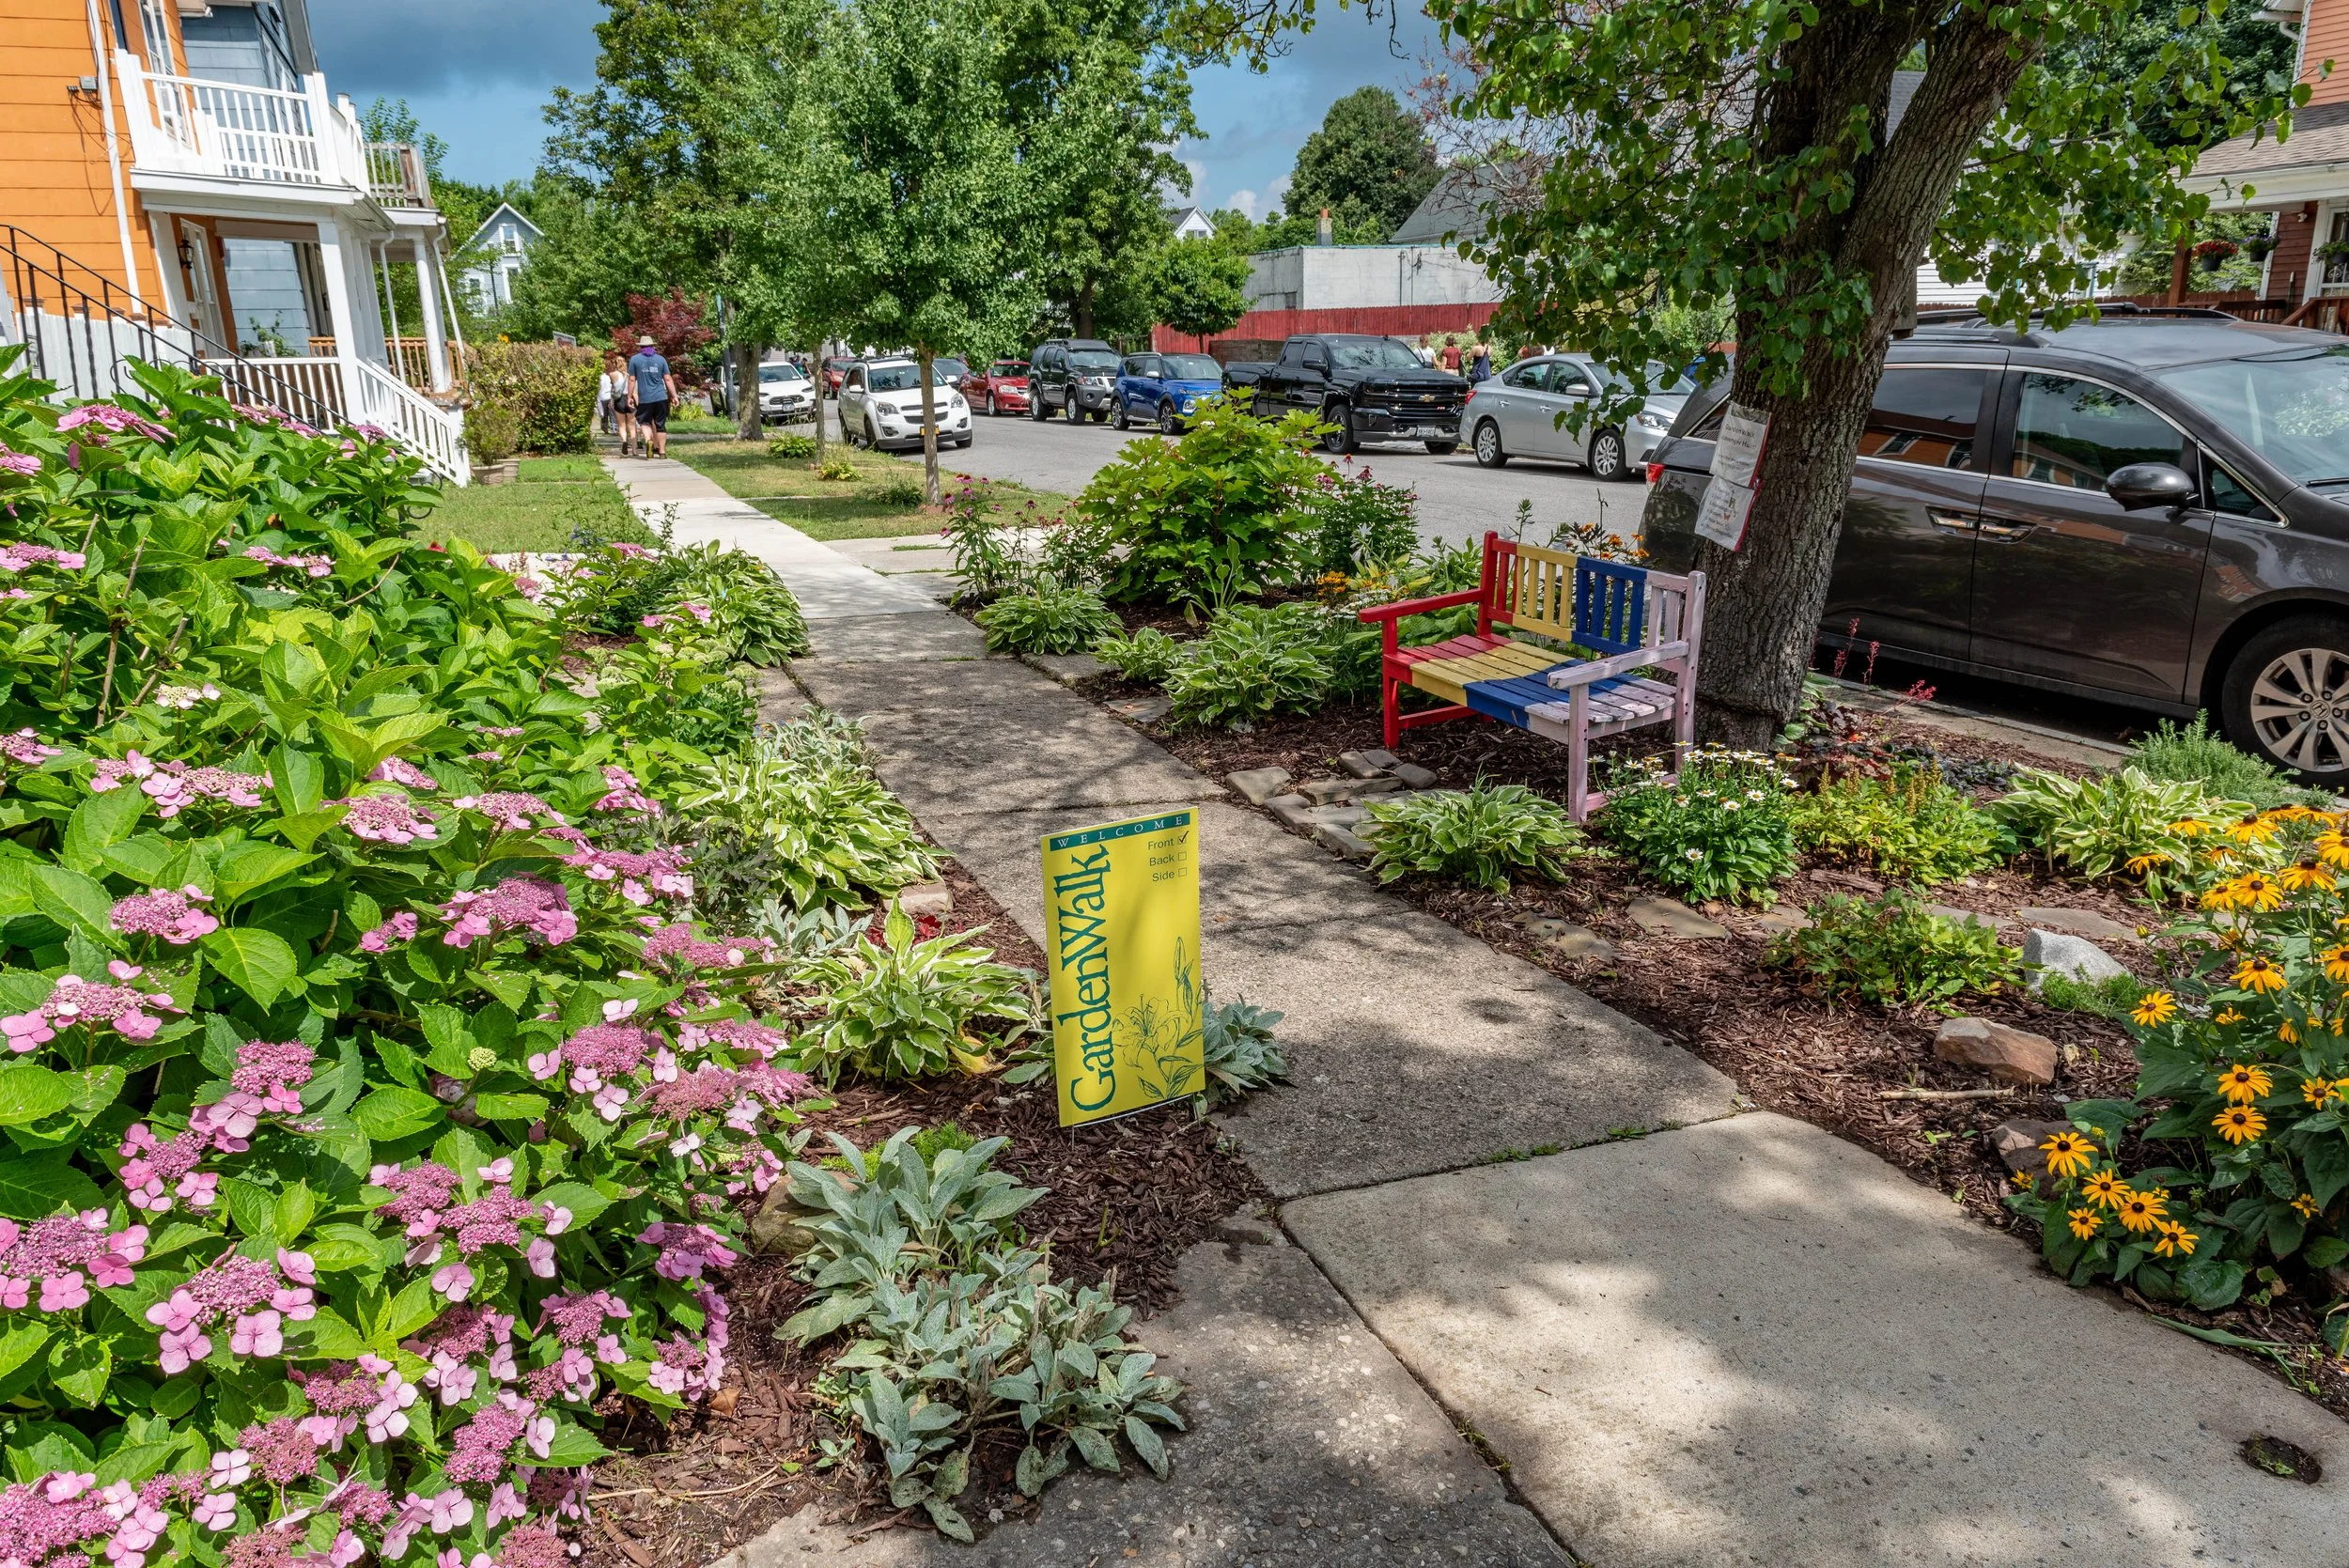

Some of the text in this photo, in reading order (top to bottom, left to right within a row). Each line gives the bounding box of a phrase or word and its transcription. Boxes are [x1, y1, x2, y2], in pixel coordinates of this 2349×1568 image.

[1058, 815, 1184, 849] WELCOME
[1147, 837, 1174, 850] Front
[1149, 853, 1175, 867] Back
[1152, 868, 1175, 882] Side
[1054, 844, 1116, 1112] GardenWalk
